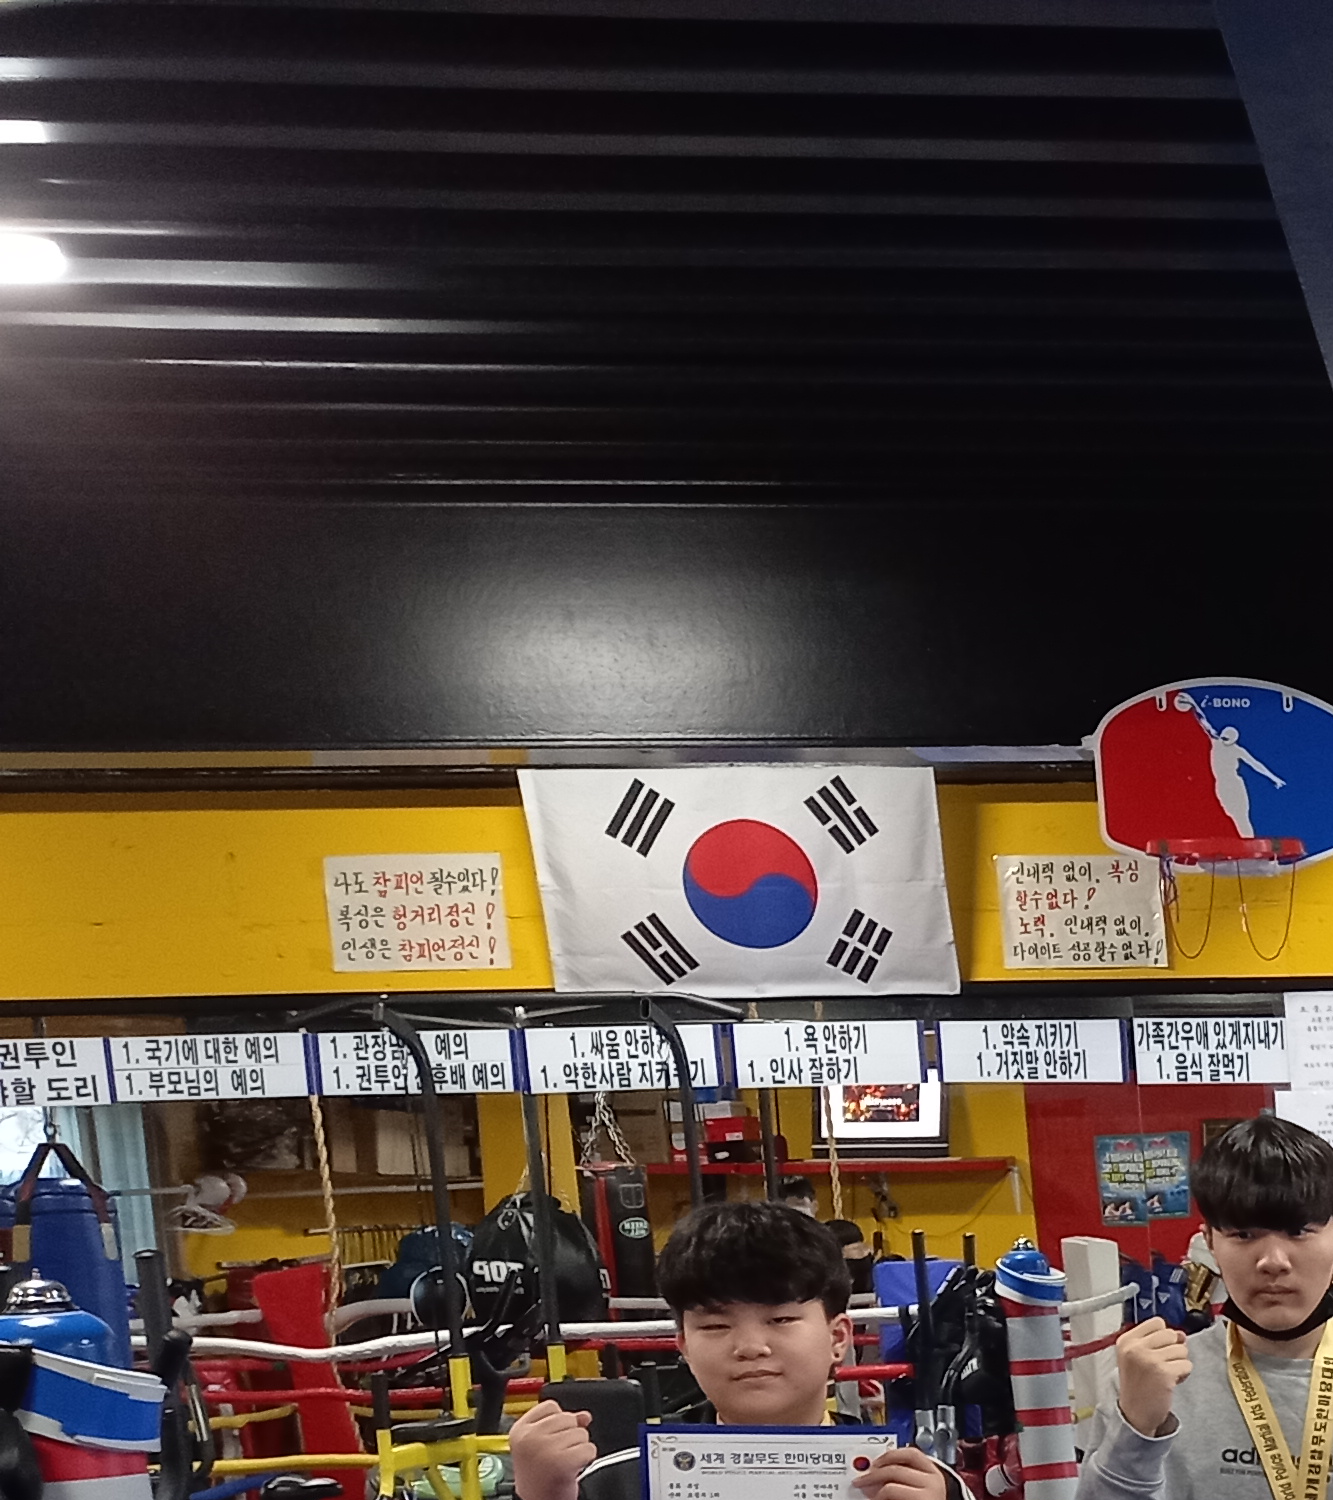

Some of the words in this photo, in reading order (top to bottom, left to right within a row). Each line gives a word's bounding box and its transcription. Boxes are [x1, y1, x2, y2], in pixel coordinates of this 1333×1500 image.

[333, 871, 369, 896] 나도
[1107, 859, 1139, 884] 복싱
[337, 904, 386, 932] 복싱은
[1064, 915, 1107, 936] 인내력
[341, 937, 391, 962] 인생은
[330, 1038, 347, 1060] 1.
[435, 1032, 469, 1060] 예의
[571, 1032, 585, 1058] 1.
[591, 1029, 619, 1056] 싸움
[785, 1027, 799, 1052] 1.
[804, 1024, 818, 1054] 욕
[823, 1024, 868, 1054] 안하기
[982, 1025, 997, 1049] 1.
[1001, 1023, 1030, 1050] 약속
[1035, 1021, 1079, 1050] 지키기
[0, 1039, 77, 1070] 권투인
[122, 1041, 140, 1064] 1.
[145, 1038, 199, 1067] 국기에
[205, 1036, 238, 1064] 대한
[245, 1035, 279, 1063] 예의
[977, 1054, 991, 1077] 1.
[996, 1051, 1039, 1080] 거짓말
[1044, 1050, 1088, 1079] 안하기
[333, 1066, 350, 1089] 1.
[355, 1064, 408, 1091] 권투인
[472, 1062, 506, 1089] 예의
[541, 1065, 557, 1088] 1.
[748, 1060, 764, 1083] 1.
[770, 1057, 803, 1084] 인사
[809, 1057, 859, 1083] 잘하기
[1157, 1055, 1171, 1079] 1.
[1175, 1053, 1203, 1082] 음식
[1208, 1052, 1250, 1081] 잘먹기
[47, 1075, 99, 1102] 도리
[125, 1073, 143, 1096] 1.
[149, 1068, 219, 1097] 부모님의
[231, 1068, 265, 1095] 예의
[700, 1453, 725, 1465] 세계
